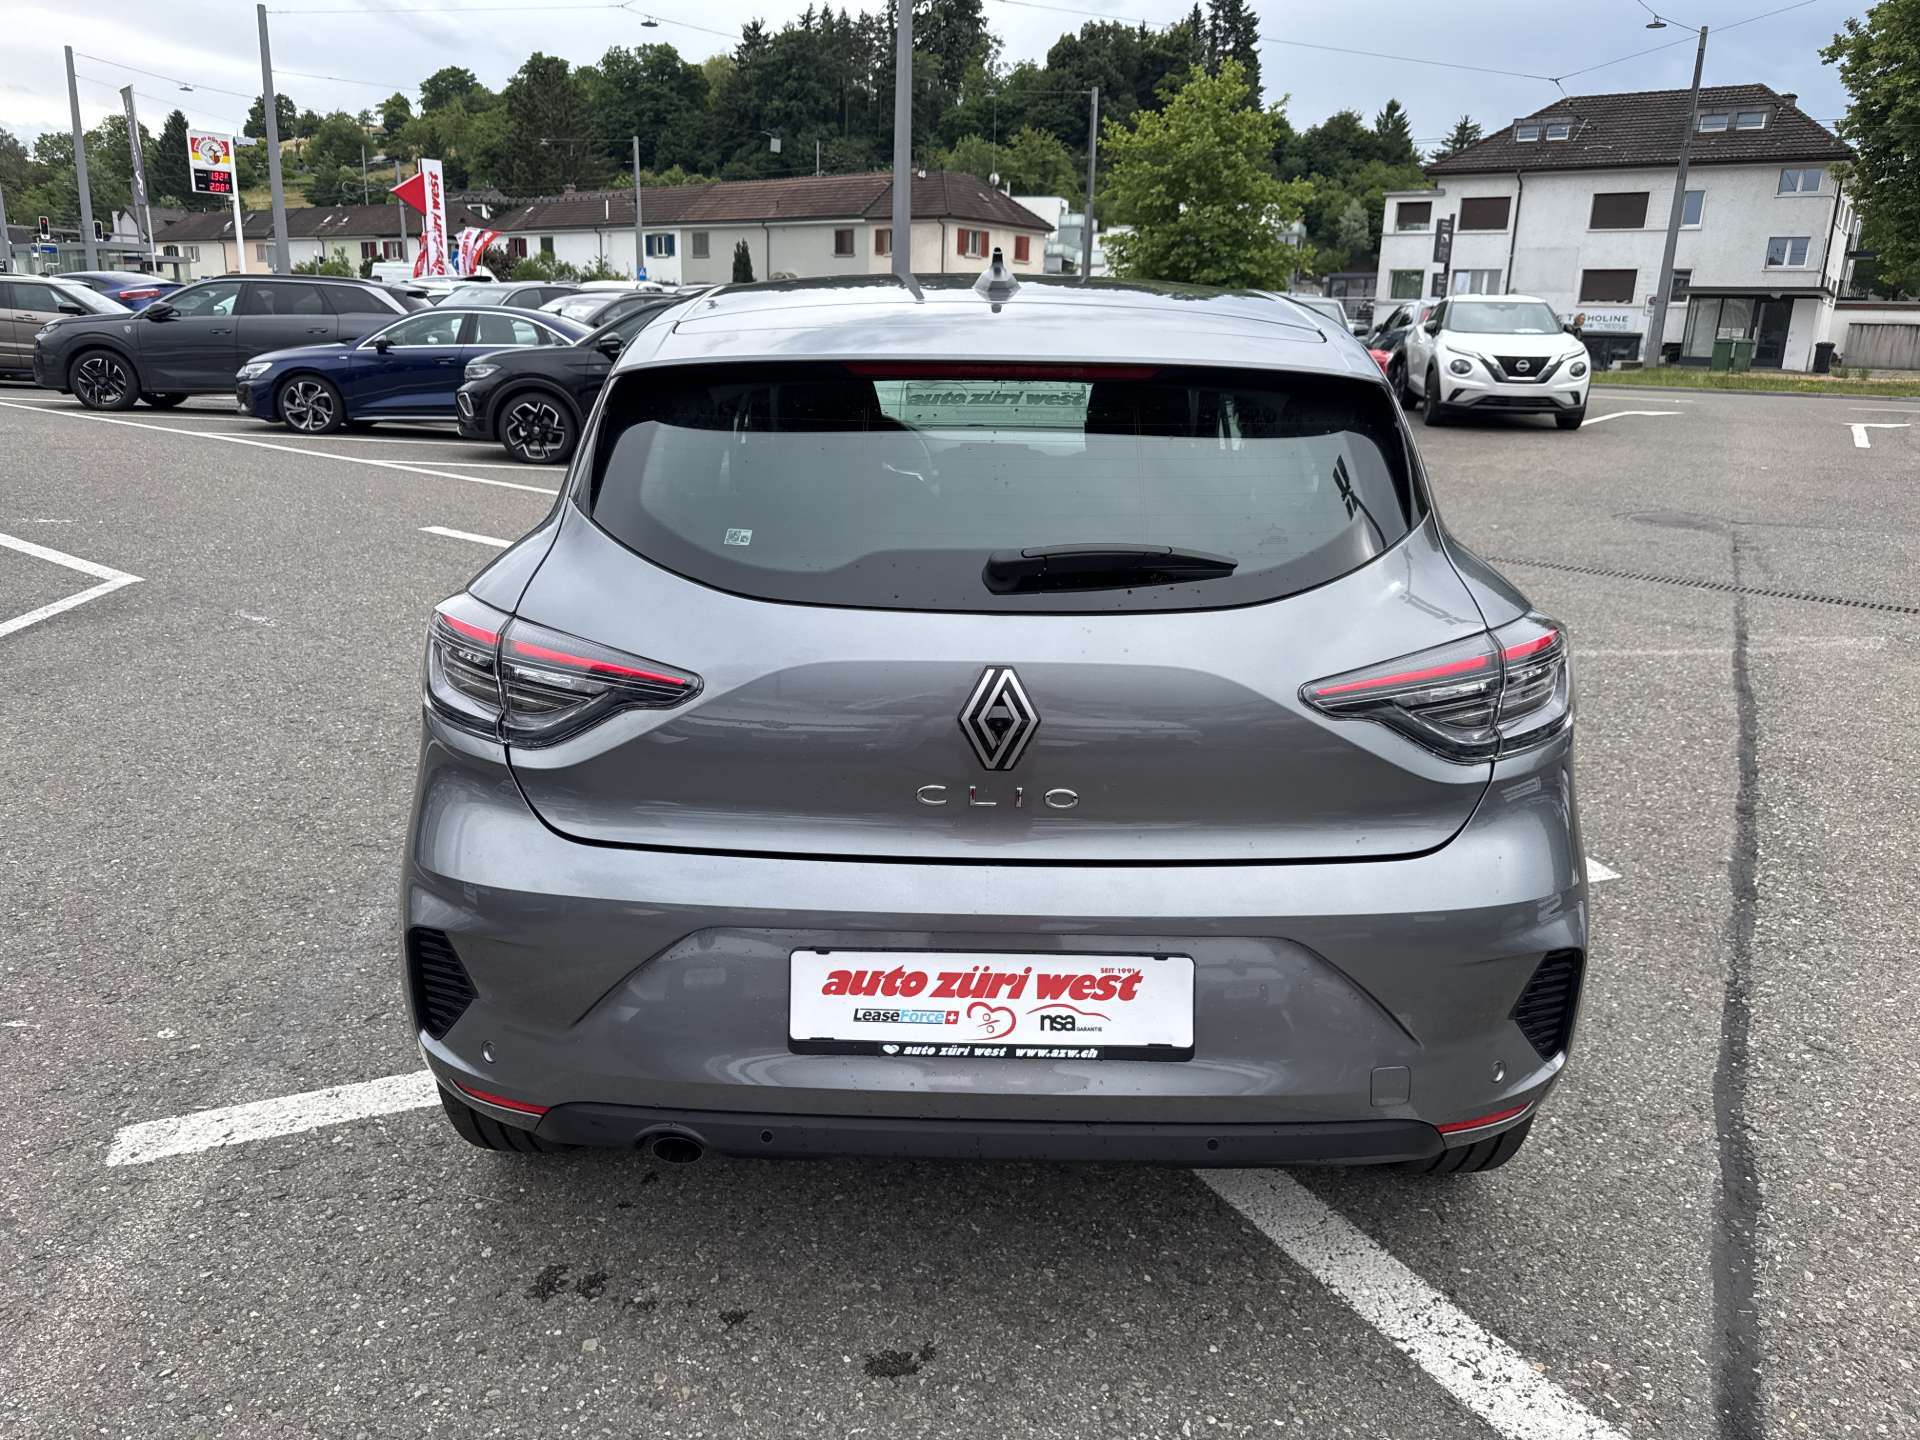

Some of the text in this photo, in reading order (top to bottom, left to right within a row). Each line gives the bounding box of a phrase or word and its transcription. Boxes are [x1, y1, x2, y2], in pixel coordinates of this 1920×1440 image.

[429, 170, 441, 210] west
[1567, 313, 1629, 323] THOLINE
[908, 390, 1086, 406] auto züri west
[916, 784, 1079, 808] CLIO
[821, 964, 1145, 1001] auto züri west
[853, 1008, 945, 1024] LeaseForce
[1040, 1014, 1076, 1032] nsa
[903, 1044, 1098, 1059] auto züri west www.azw.ch
